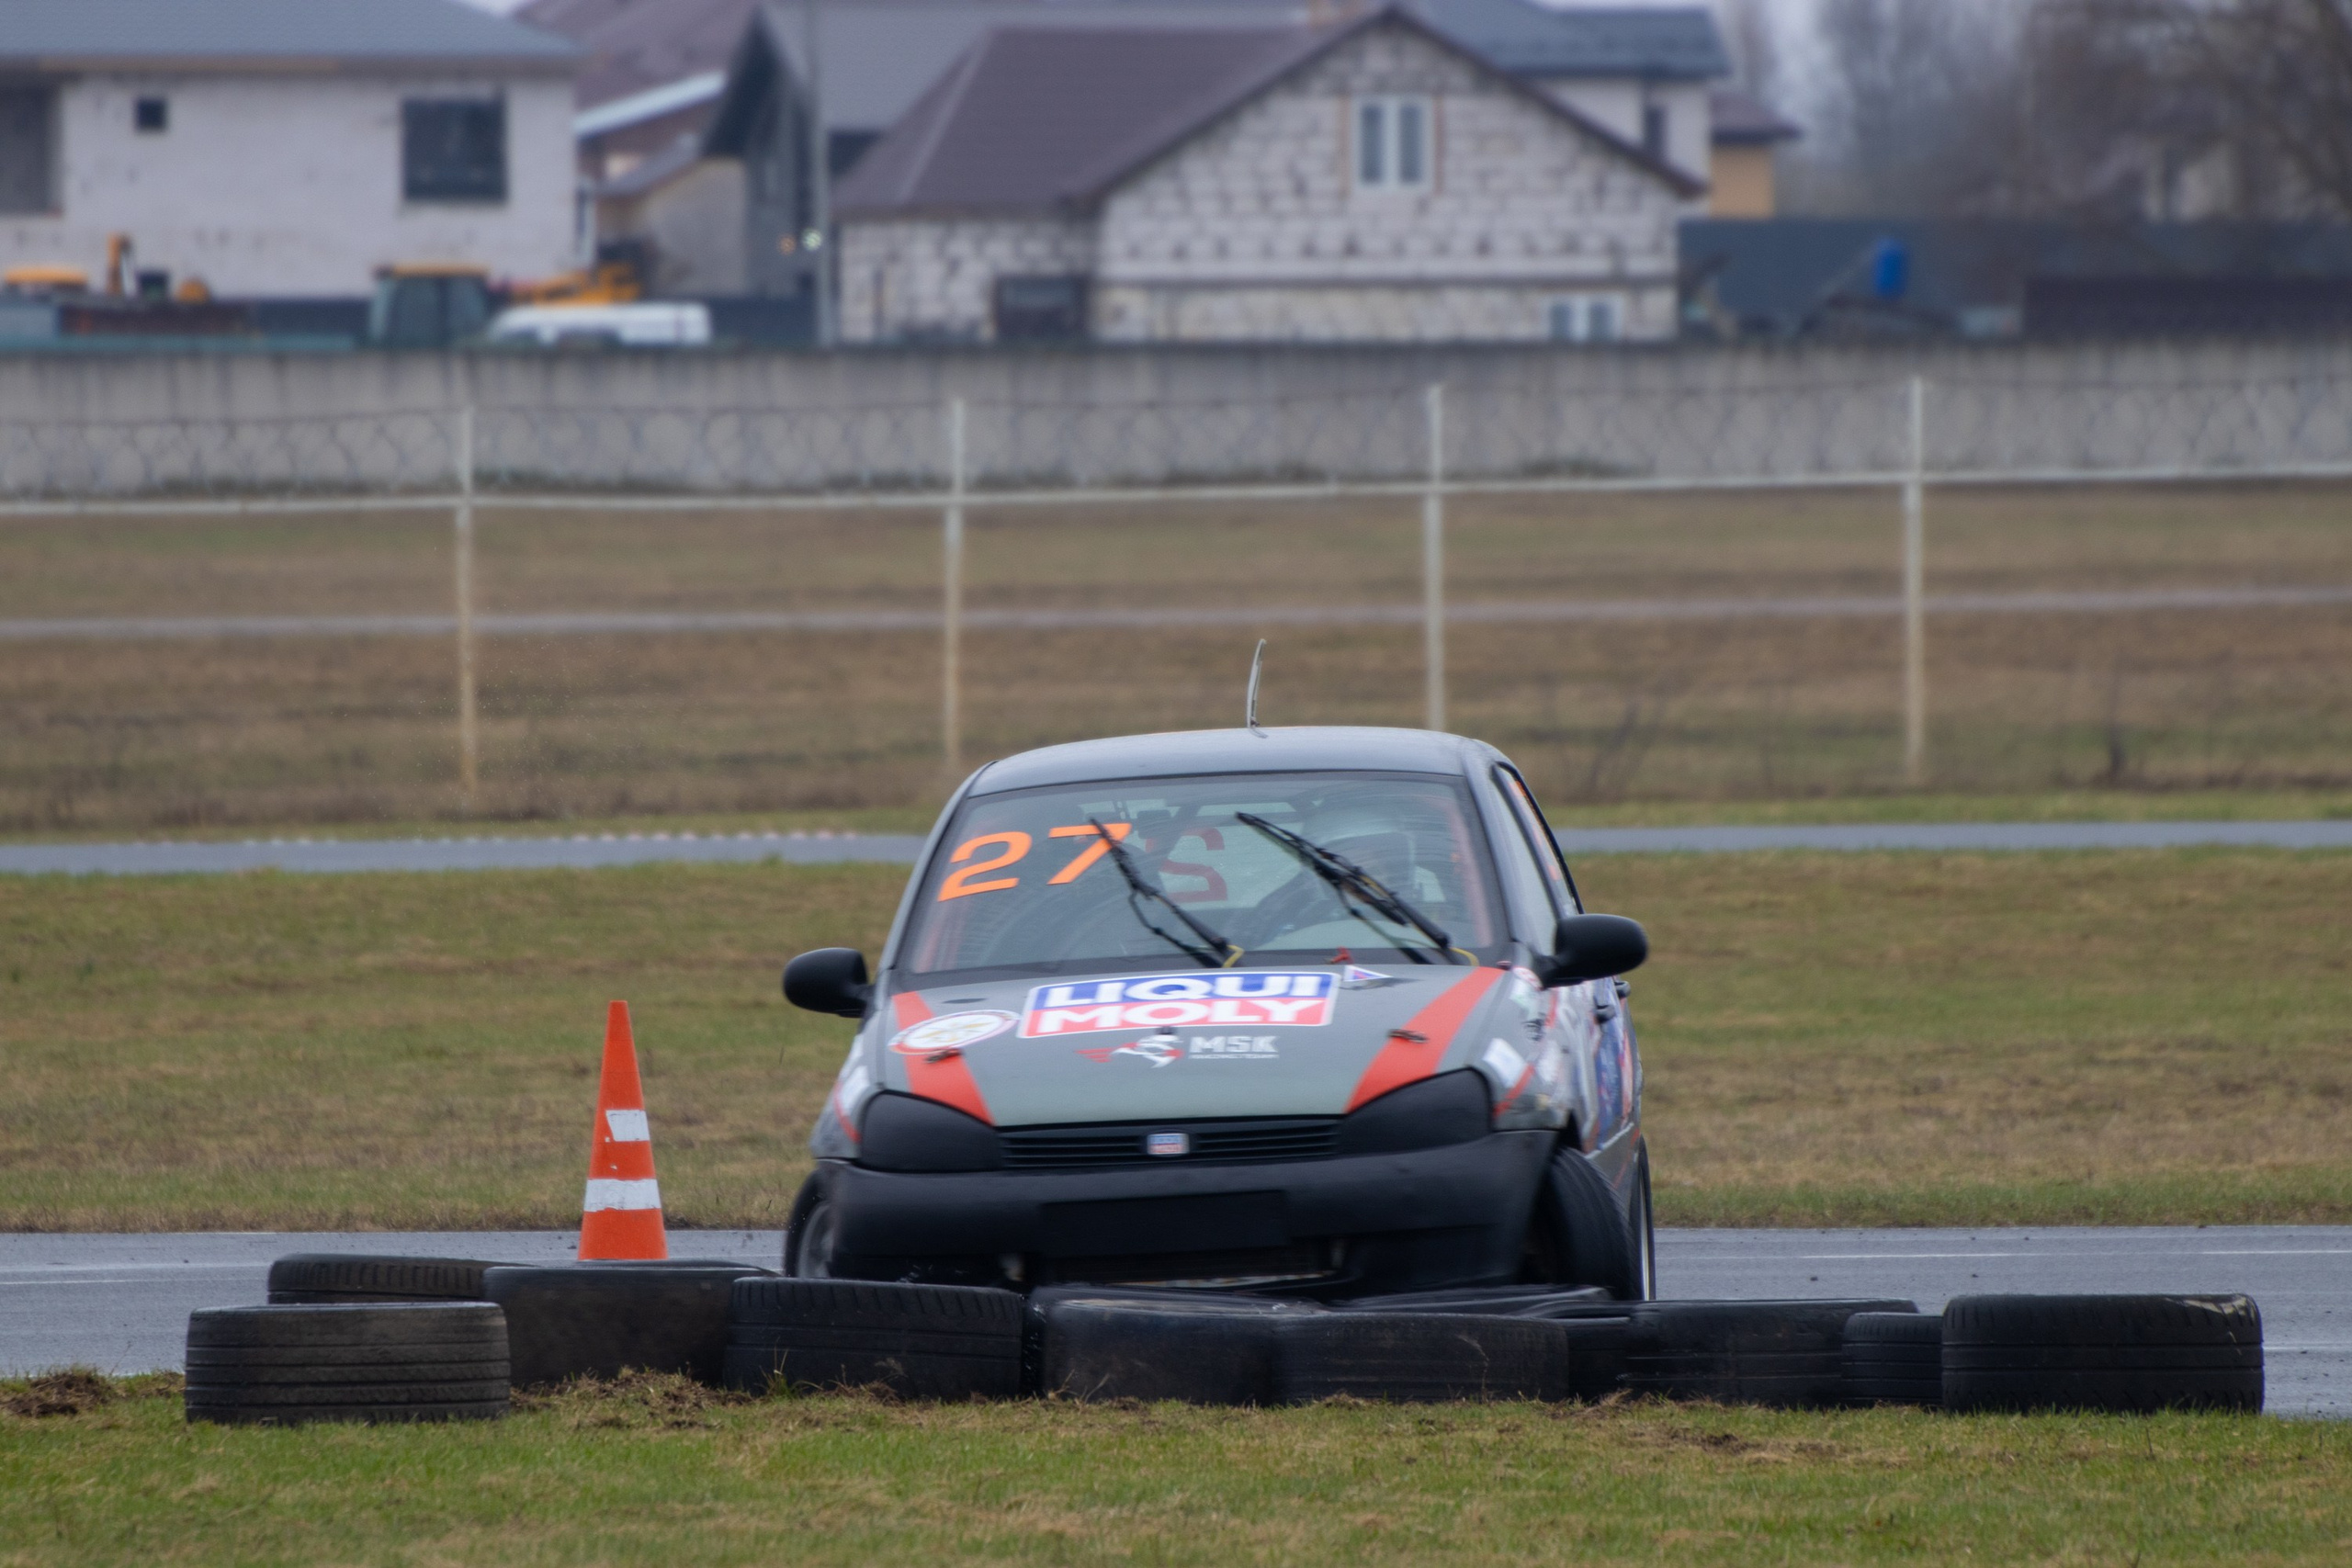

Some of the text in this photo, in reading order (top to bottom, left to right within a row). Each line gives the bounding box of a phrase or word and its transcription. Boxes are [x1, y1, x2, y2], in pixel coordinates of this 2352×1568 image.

[936, 823, 1132, 902] 27
[1045, 976, 1322, 1008] LIQUI
[1036, 999, 1325, 1033] MOLY
[1189, 1035, 1279, 1053] MSK
